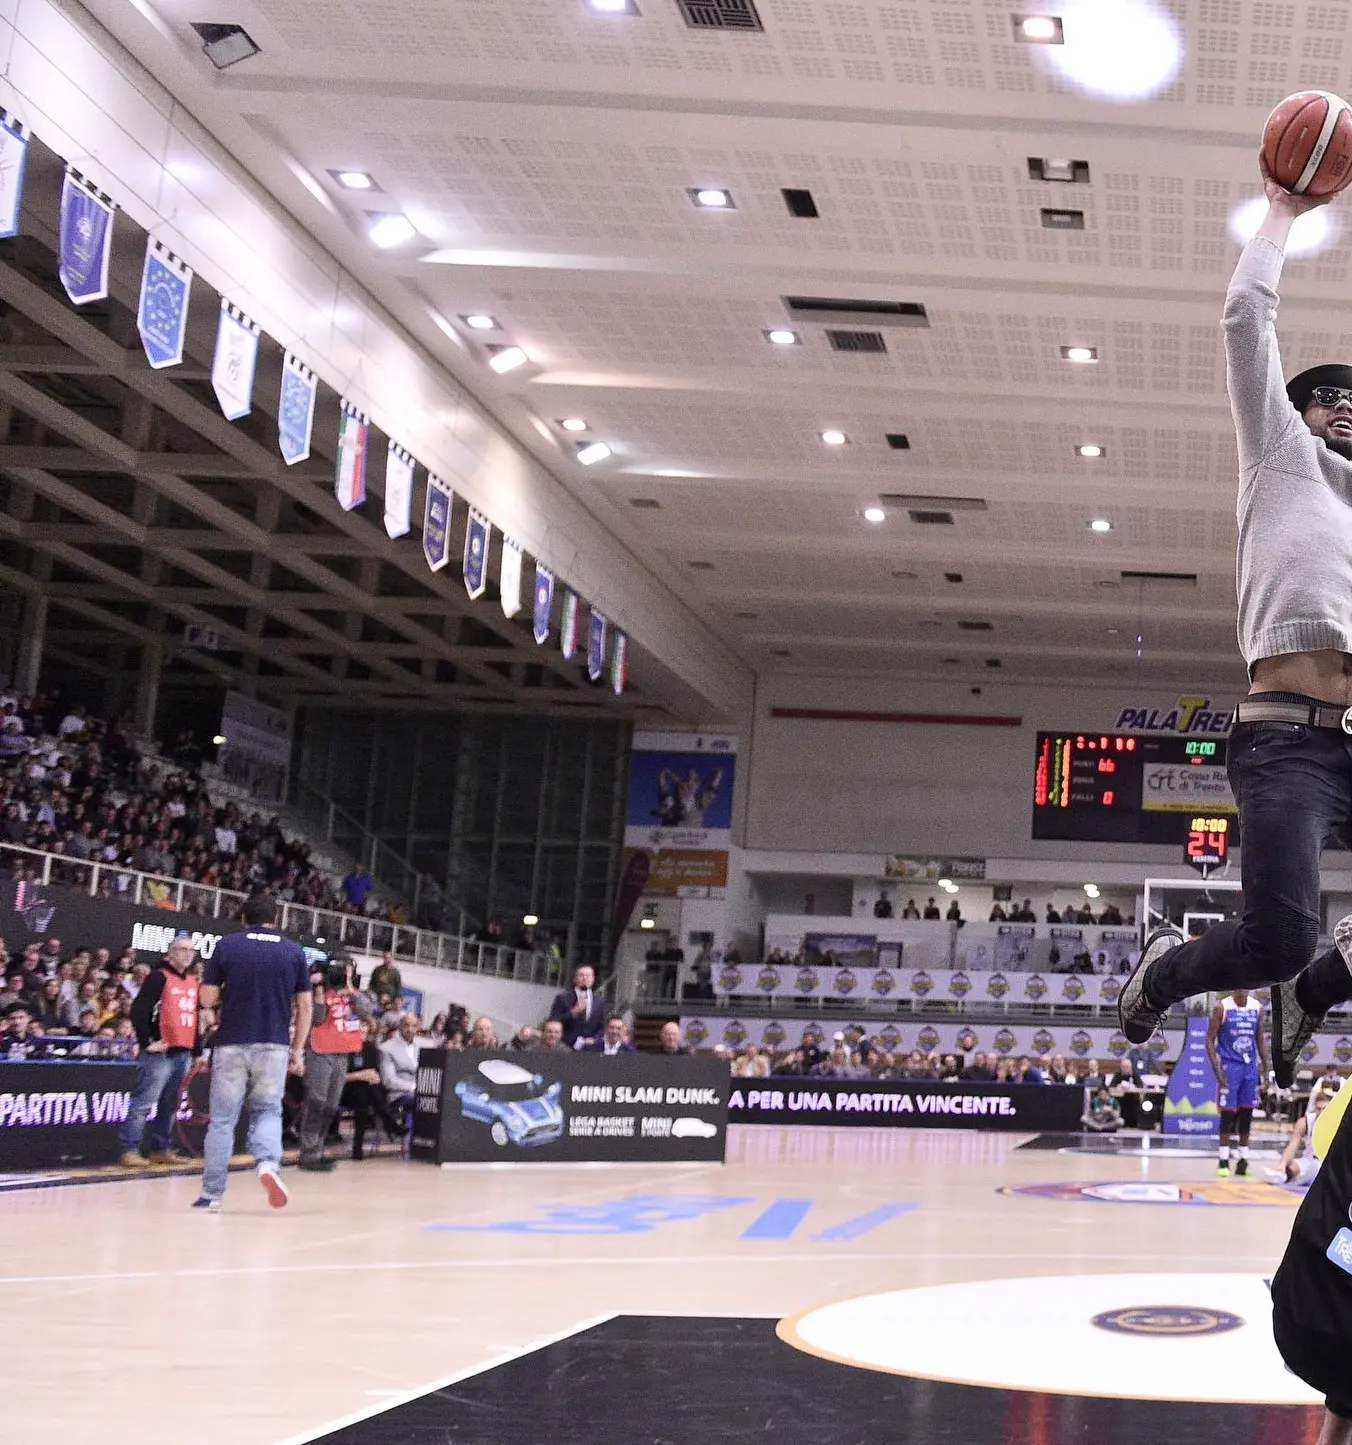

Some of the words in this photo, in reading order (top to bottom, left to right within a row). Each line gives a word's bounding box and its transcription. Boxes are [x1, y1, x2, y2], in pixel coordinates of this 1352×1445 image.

[1187, 832, 1225, 856] 24
[571, 1086, 612, 1105] MINI
[615, 1087, 664, 1104] SLAM
[666, 1088, 720, 1105] DUNK.
[728, 1090, 745, 1109] A
[748, 1091, 784, 1110] PER
[787, 1092, 832, 1111] UNA
[835, 1092, 913, 1113] PARTITA
[916, 1095, 1017, 1116] VINCENTE.
[0, 1092, 88, 1127] PARTITA
